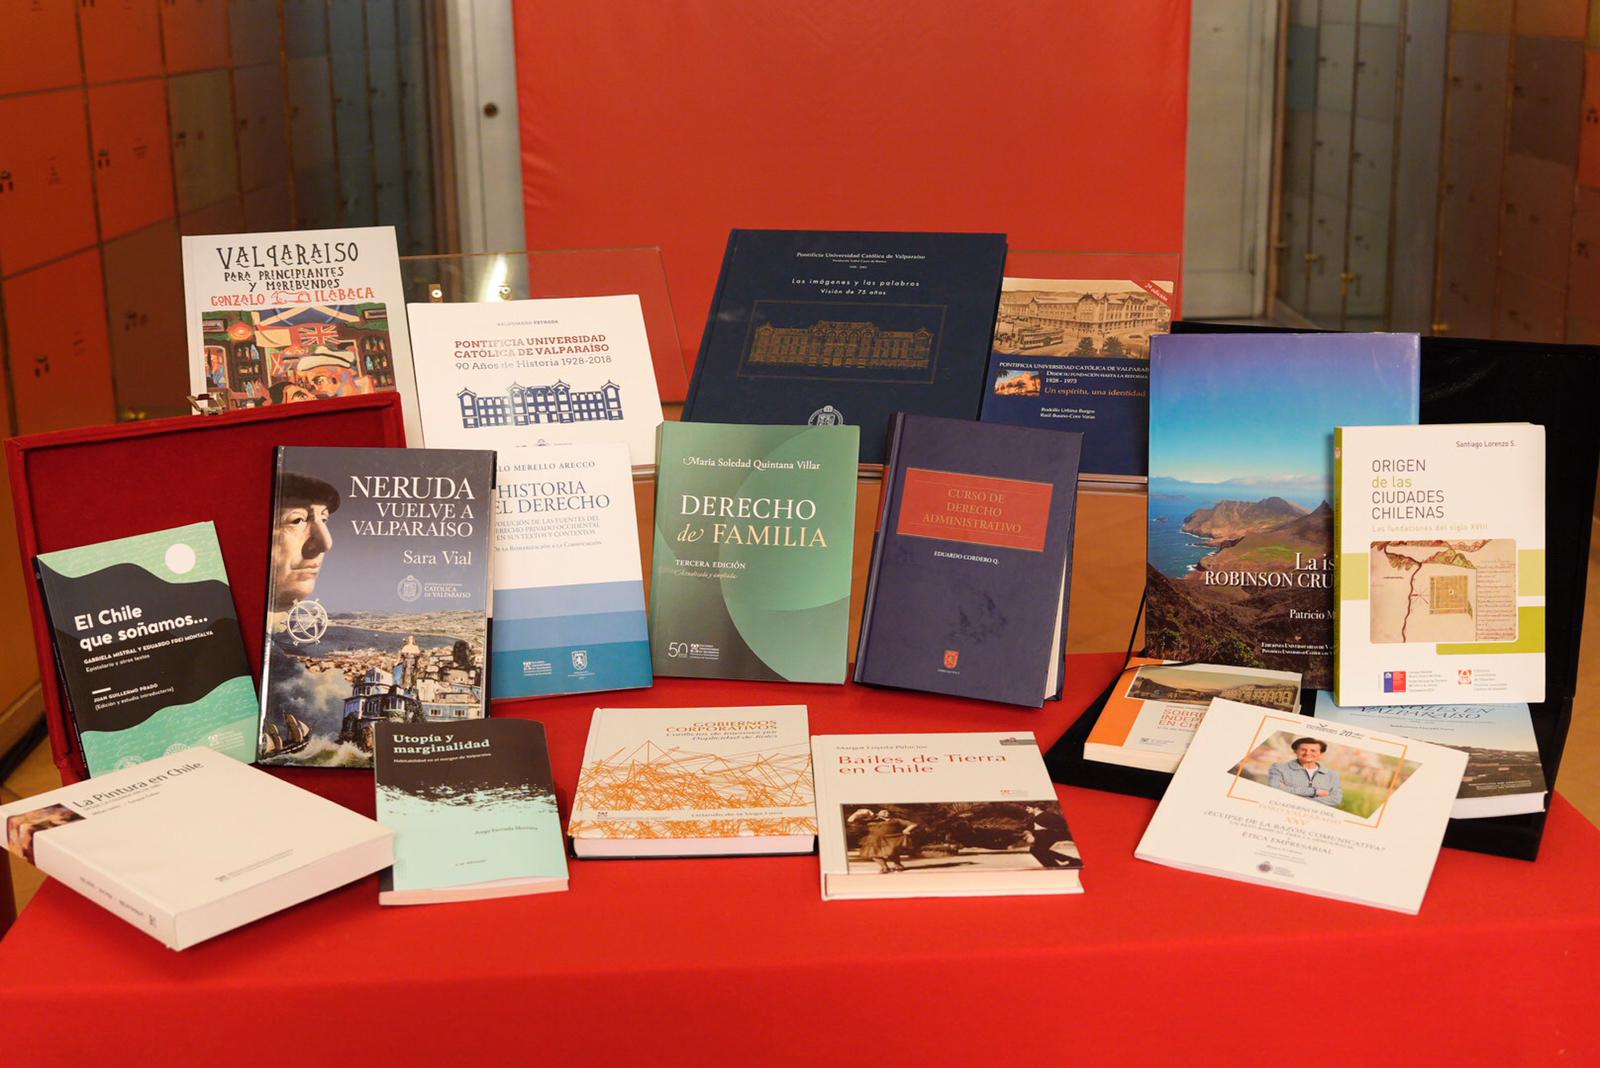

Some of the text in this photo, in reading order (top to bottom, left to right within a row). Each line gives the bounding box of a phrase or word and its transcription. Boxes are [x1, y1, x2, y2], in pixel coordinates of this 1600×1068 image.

[217, 242, 359, 269] VALPARAISO
[224, 267, 344, 282] PARA PRINCIPIANTES
[266, 279, 340, 291] MORIBUNDOS
[211, 288, 375, 307] GONZALO ILABACA
[455, 335, 606, 349] PONTIFICIA UNIVERSIDAD
[455, 343, 609, 359] CATÓLICA DE VALPARAÍSO
[456, 356, 612, 370] 90 Años de Historia 1928-2018
[1108, 389, 1145, 397] identidad
[1456, 440, 1482, 448] Santiago
[683, 456, 821, 471] María Soledad Quintana Villar
[1372, 459, 1426, 472] ORIGEN
[349, 476, 475, 500] NERUDA
[1372, 475, 1412, 488] de las
[498, 481, 586, 498] HISTORIA
[948, 489, 1005, 504] CURSO DE
[1372, 490, 1445, 504] CIUDADES
[376, 502, 474, 519] VUELVE A
[519, 495, 610, 513] DERECHO
[681, 494, 816, 520] DERECHO
[947, 502, 1002, 517] DERECHO
[1372, 506, 1445, 520] CHILENAS
[352, 517, 473, 537] VALPARAÍSO
[922, 514, 1022, 534] ADMINISTRATIVO
[677, 523, 828, 548] de FAMILIA
[404, 550, 471, 565] Sara Vial
[713, 560, 745, 569] EDICIÓN
[934, 551, 962, 559] EDUARDO
[964, 555, 992, 563] CORDERO
[1296, 552, 1335, 571] La is
[1205, 571, 1333, 588] ROBINSON CRU
[74, 605, 142, 630] El Chile
[1290, 609, 1324, 620] Patricio
[80, 615, 208, 651] que soñamos...
[84, 654, 112, 664] GABRIELA
[113, 649, 137, 658] MISTRAL
[143, 640, 170, 651] EDUARDO
[185, 631, 214, 641] MONTALVA
[86, 662, 114, 672] Epistolario
[109, 688, 139, 699] GUILLERMO
[140, 683, 158, 692] PRADO
[393, 734, 454, 744] Utopía y
[394, 739, 490, 755] marginalidad
[839, 754, 1007, 765] Bailes de Tierra
[839, 764, 934, 774] en Chile
[72, 798, 94, 808] La
[92, 781, 148, 801] Pintura
[148, 774, 168, 783] en
[167, 762, 201, 777] Chile
